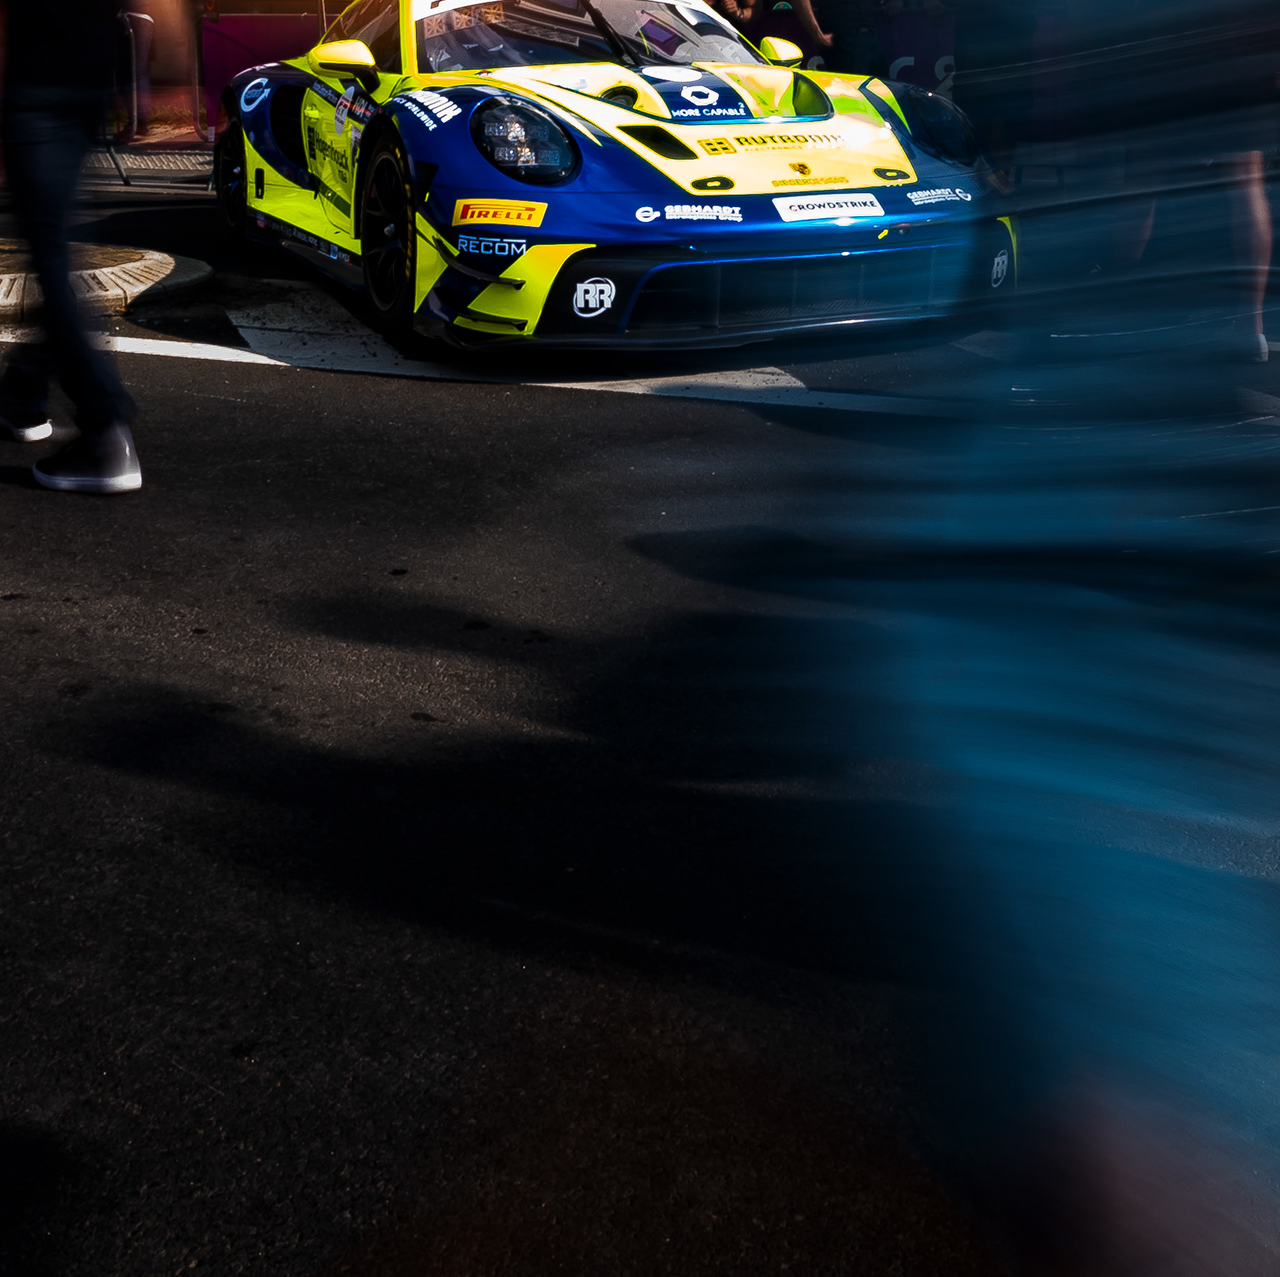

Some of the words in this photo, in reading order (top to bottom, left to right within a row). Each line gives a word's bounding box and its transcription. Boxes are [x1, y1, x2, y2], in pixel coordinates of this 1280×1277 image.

[671, 108, 701, 117] MORE
[460, 203, 534, 222] PIRELLI
[789, 199, 877, 213] CROWDSTRIKE
[458, 235, 527, 256] RECOM
